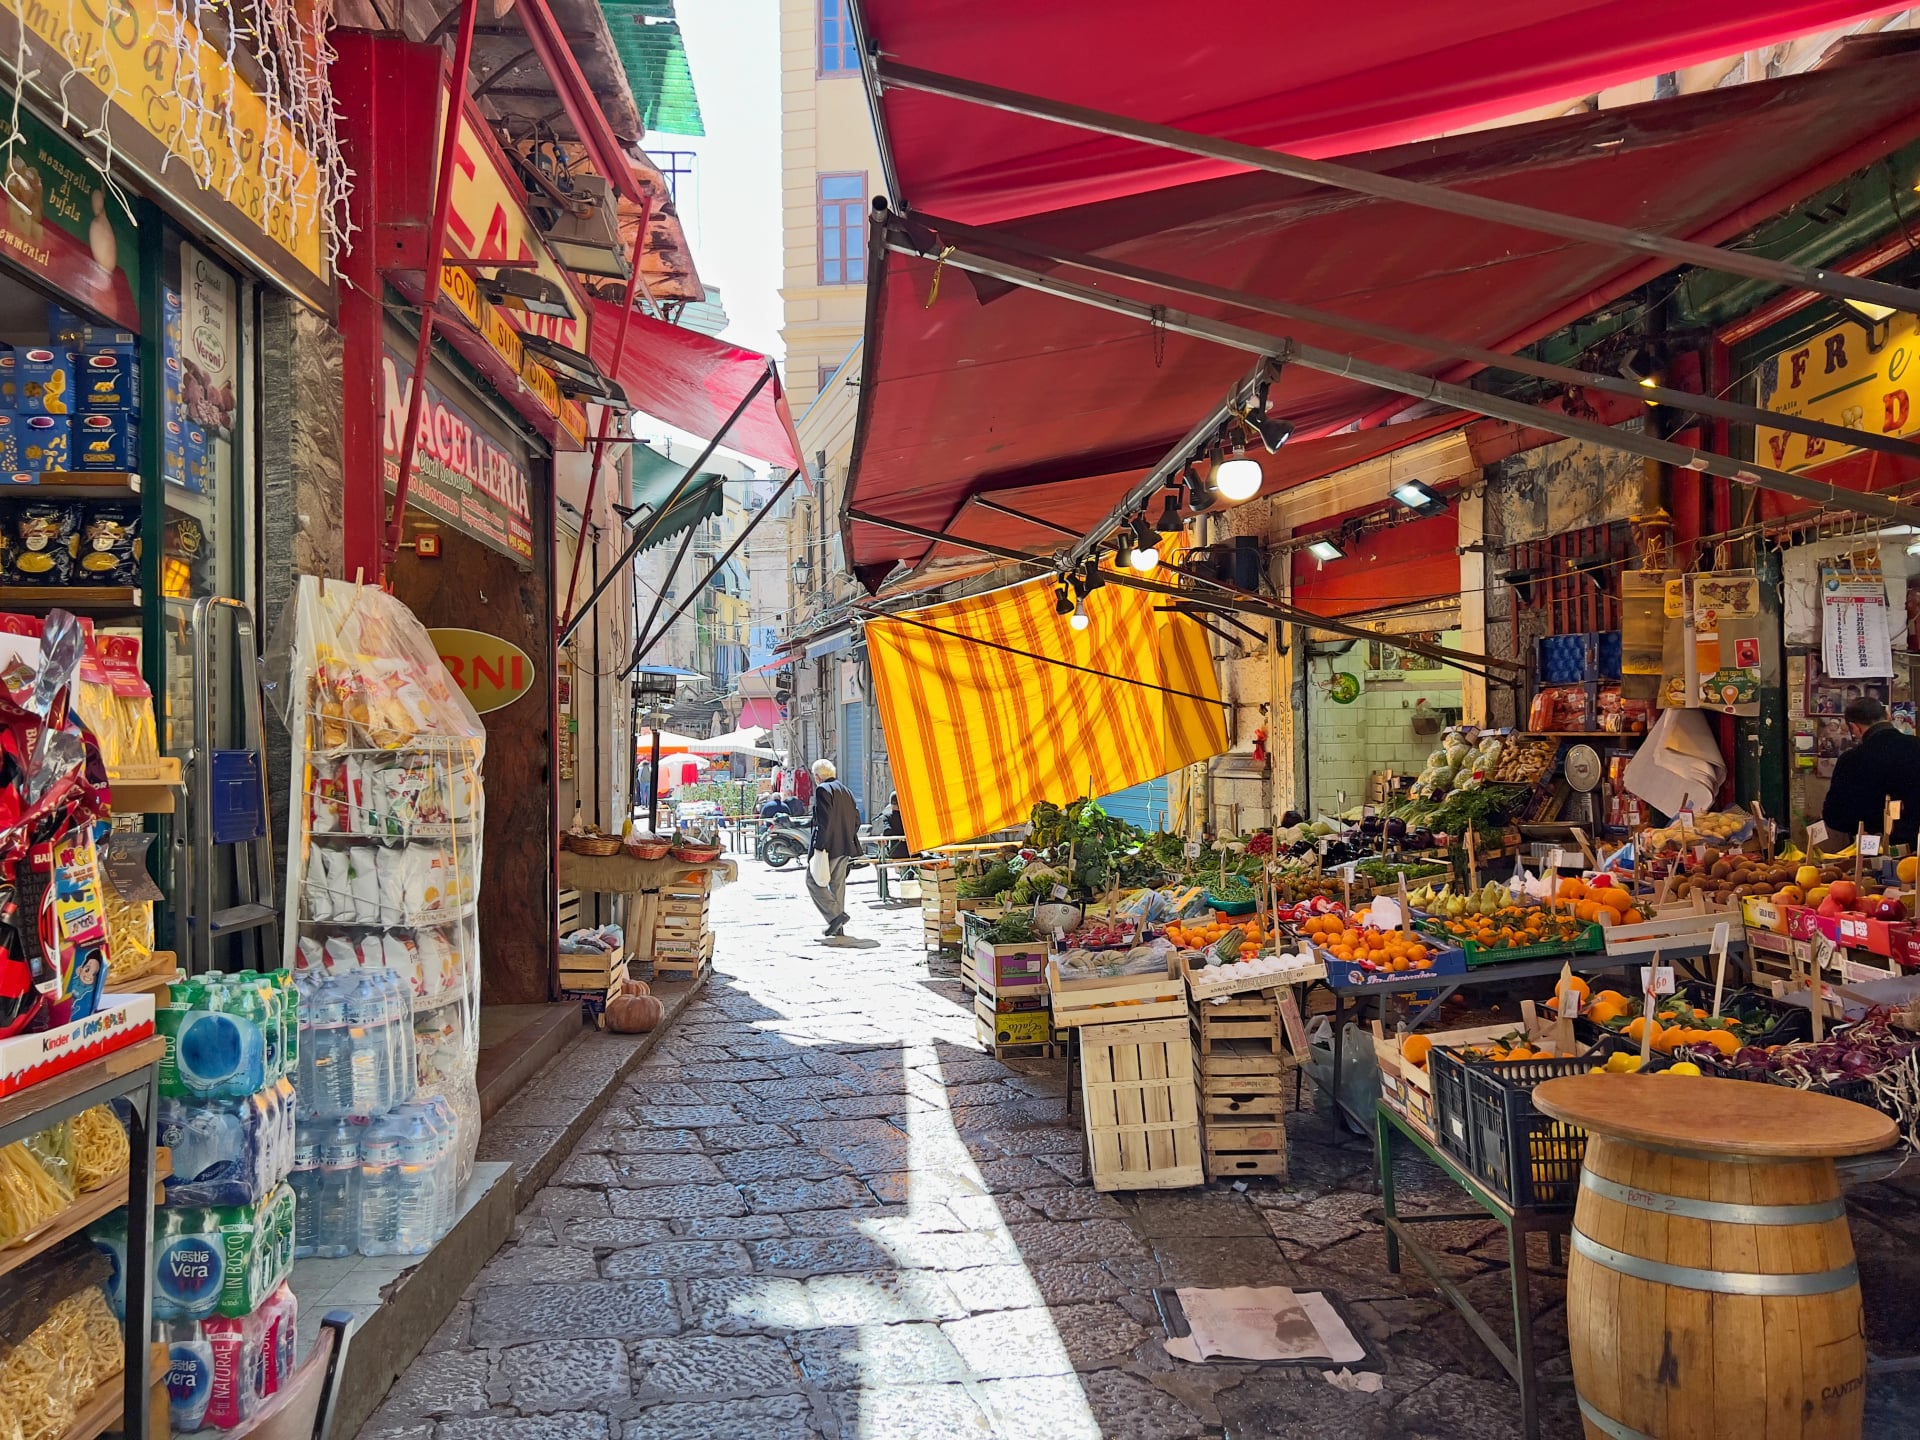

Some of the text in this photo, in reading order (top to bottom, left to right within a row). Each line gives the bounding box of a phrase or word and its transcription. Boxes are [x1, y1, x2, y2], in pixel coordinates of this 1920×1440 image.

[195, 336, 222, 369] Veroni
[383, 356, 531, 524] MACELLERIA
[1769, 388, 1910, 469] VED
[42, 1033, 69, 1053] Kinder
[170, 1250, 209, 1263] Nestlé
[170, 1263, 209, 1278] Vera
[226, 1235, 245, 1274] BOSCO
[213, 1344, 233, 1399] NATURAE
